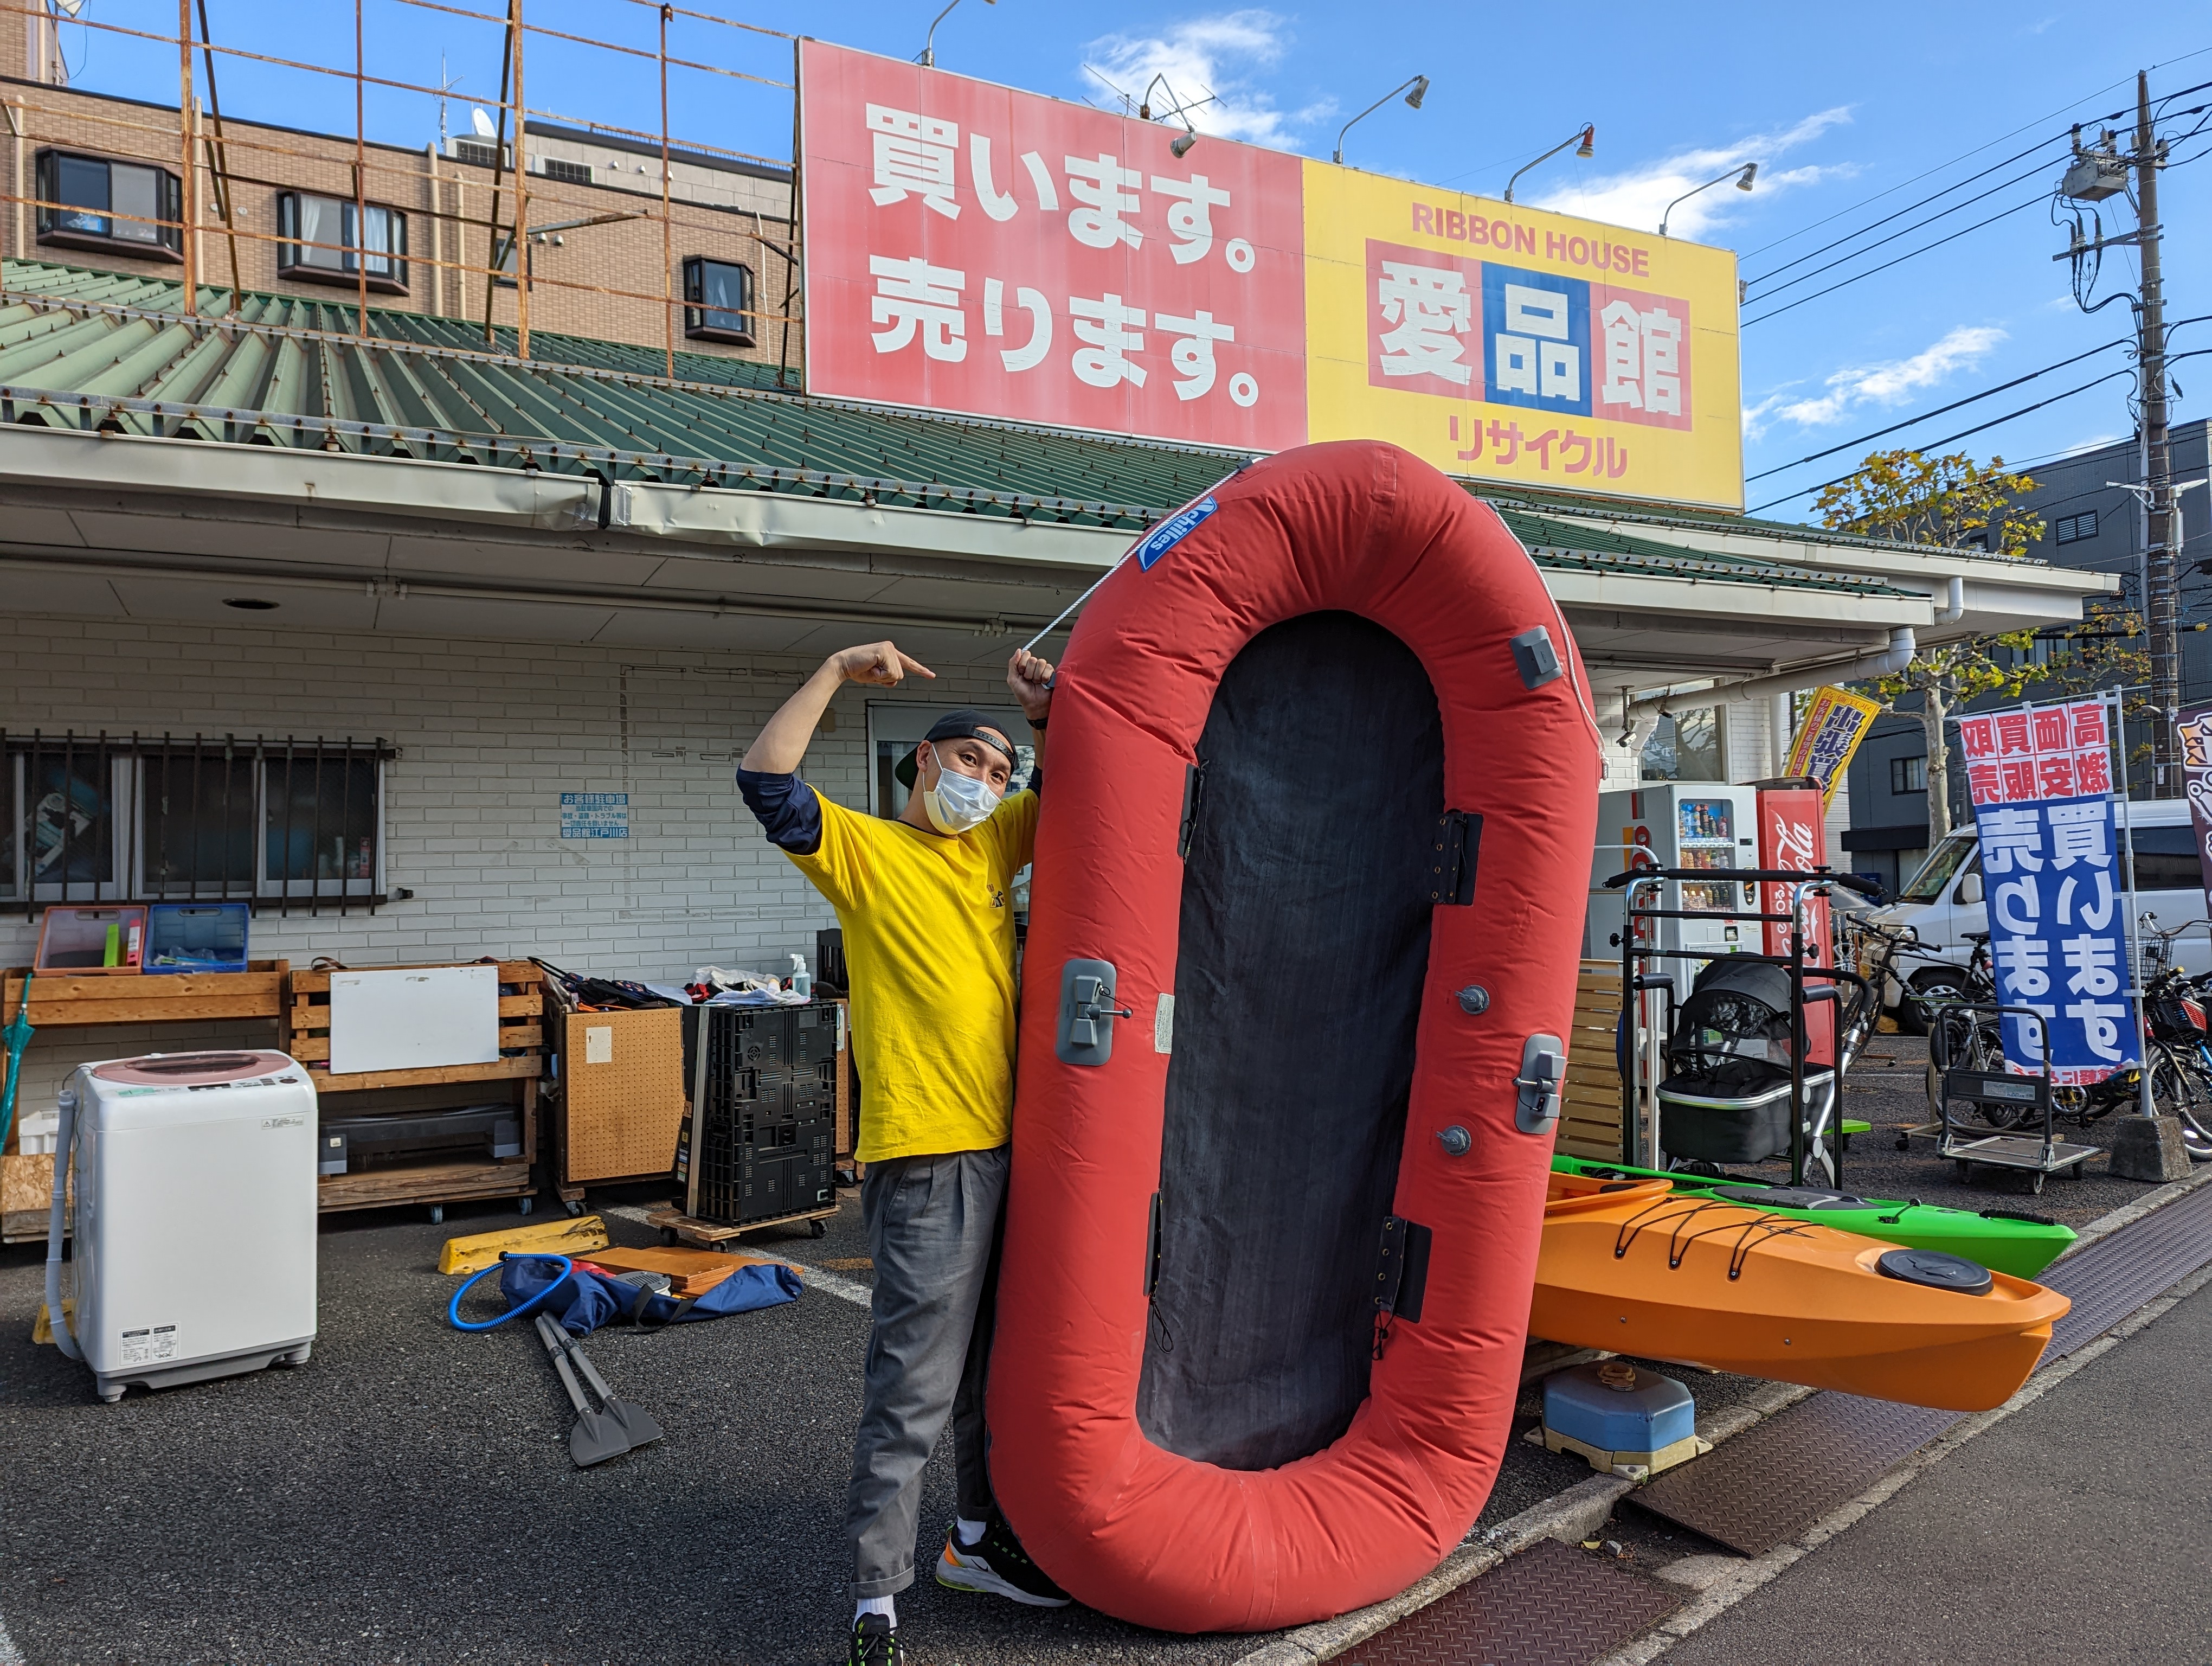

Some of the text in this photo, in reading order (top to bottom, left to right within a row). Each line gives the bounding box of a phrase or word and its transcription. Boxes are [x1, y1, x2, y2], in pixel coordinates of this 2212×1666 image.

[866, 102, 1256, 273] 買います。
[1412, 202, 1650, 278] RIBBON HOUSE
[869, 254, 1259, 407] 売ります。
[1379, 260, 1682, 416] 愛品館
[1449, 415, 1628, 478] リサイクル
[1806, 704, 1866, 795] 出張買
[562, 828, 628, 838] 愛品館江戸川店
[564, 794, 626, 804] お客様駐車場
[1770, 809, 1820, 968] C-Cola
